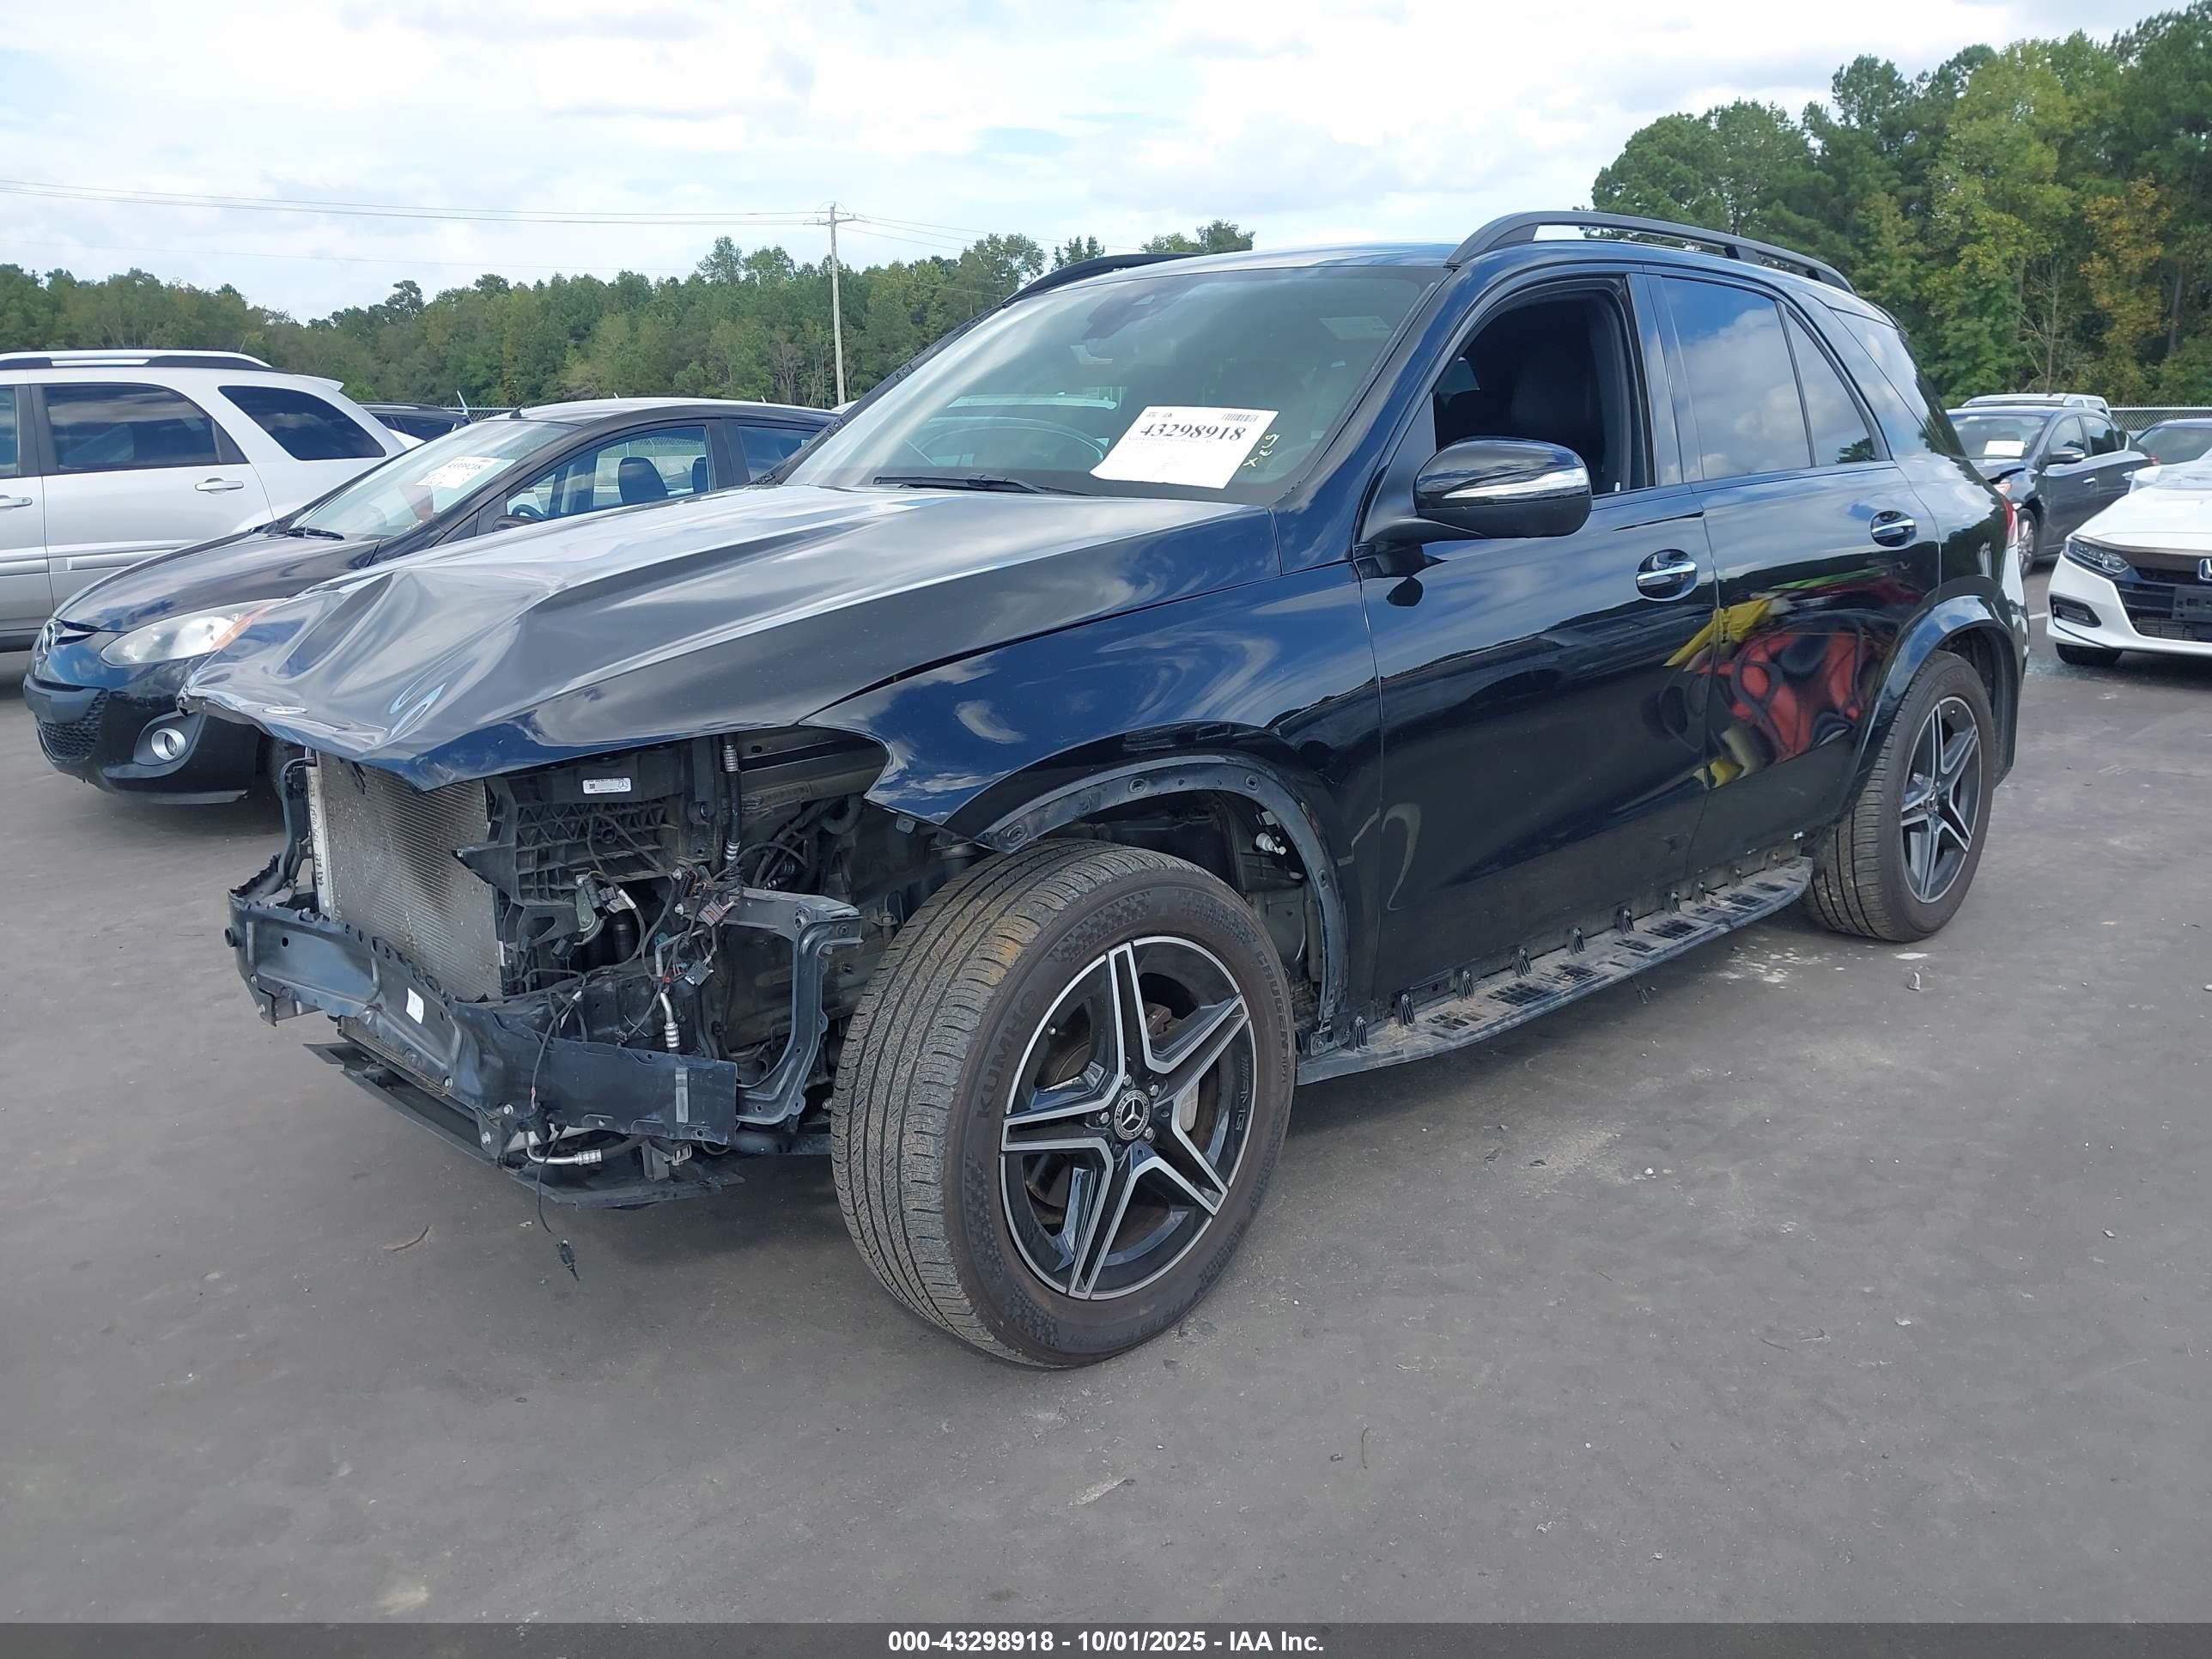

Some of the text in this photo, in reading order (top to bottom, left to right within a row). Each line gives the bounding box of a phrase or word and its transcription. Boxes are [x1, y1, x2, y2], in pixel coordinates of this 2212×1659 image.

[1140, 423, 1246, 441] 43298918
[1255, 951, 1289, 1048] CRUGEN
[976, 990, 1036, 1118] KUMHO
